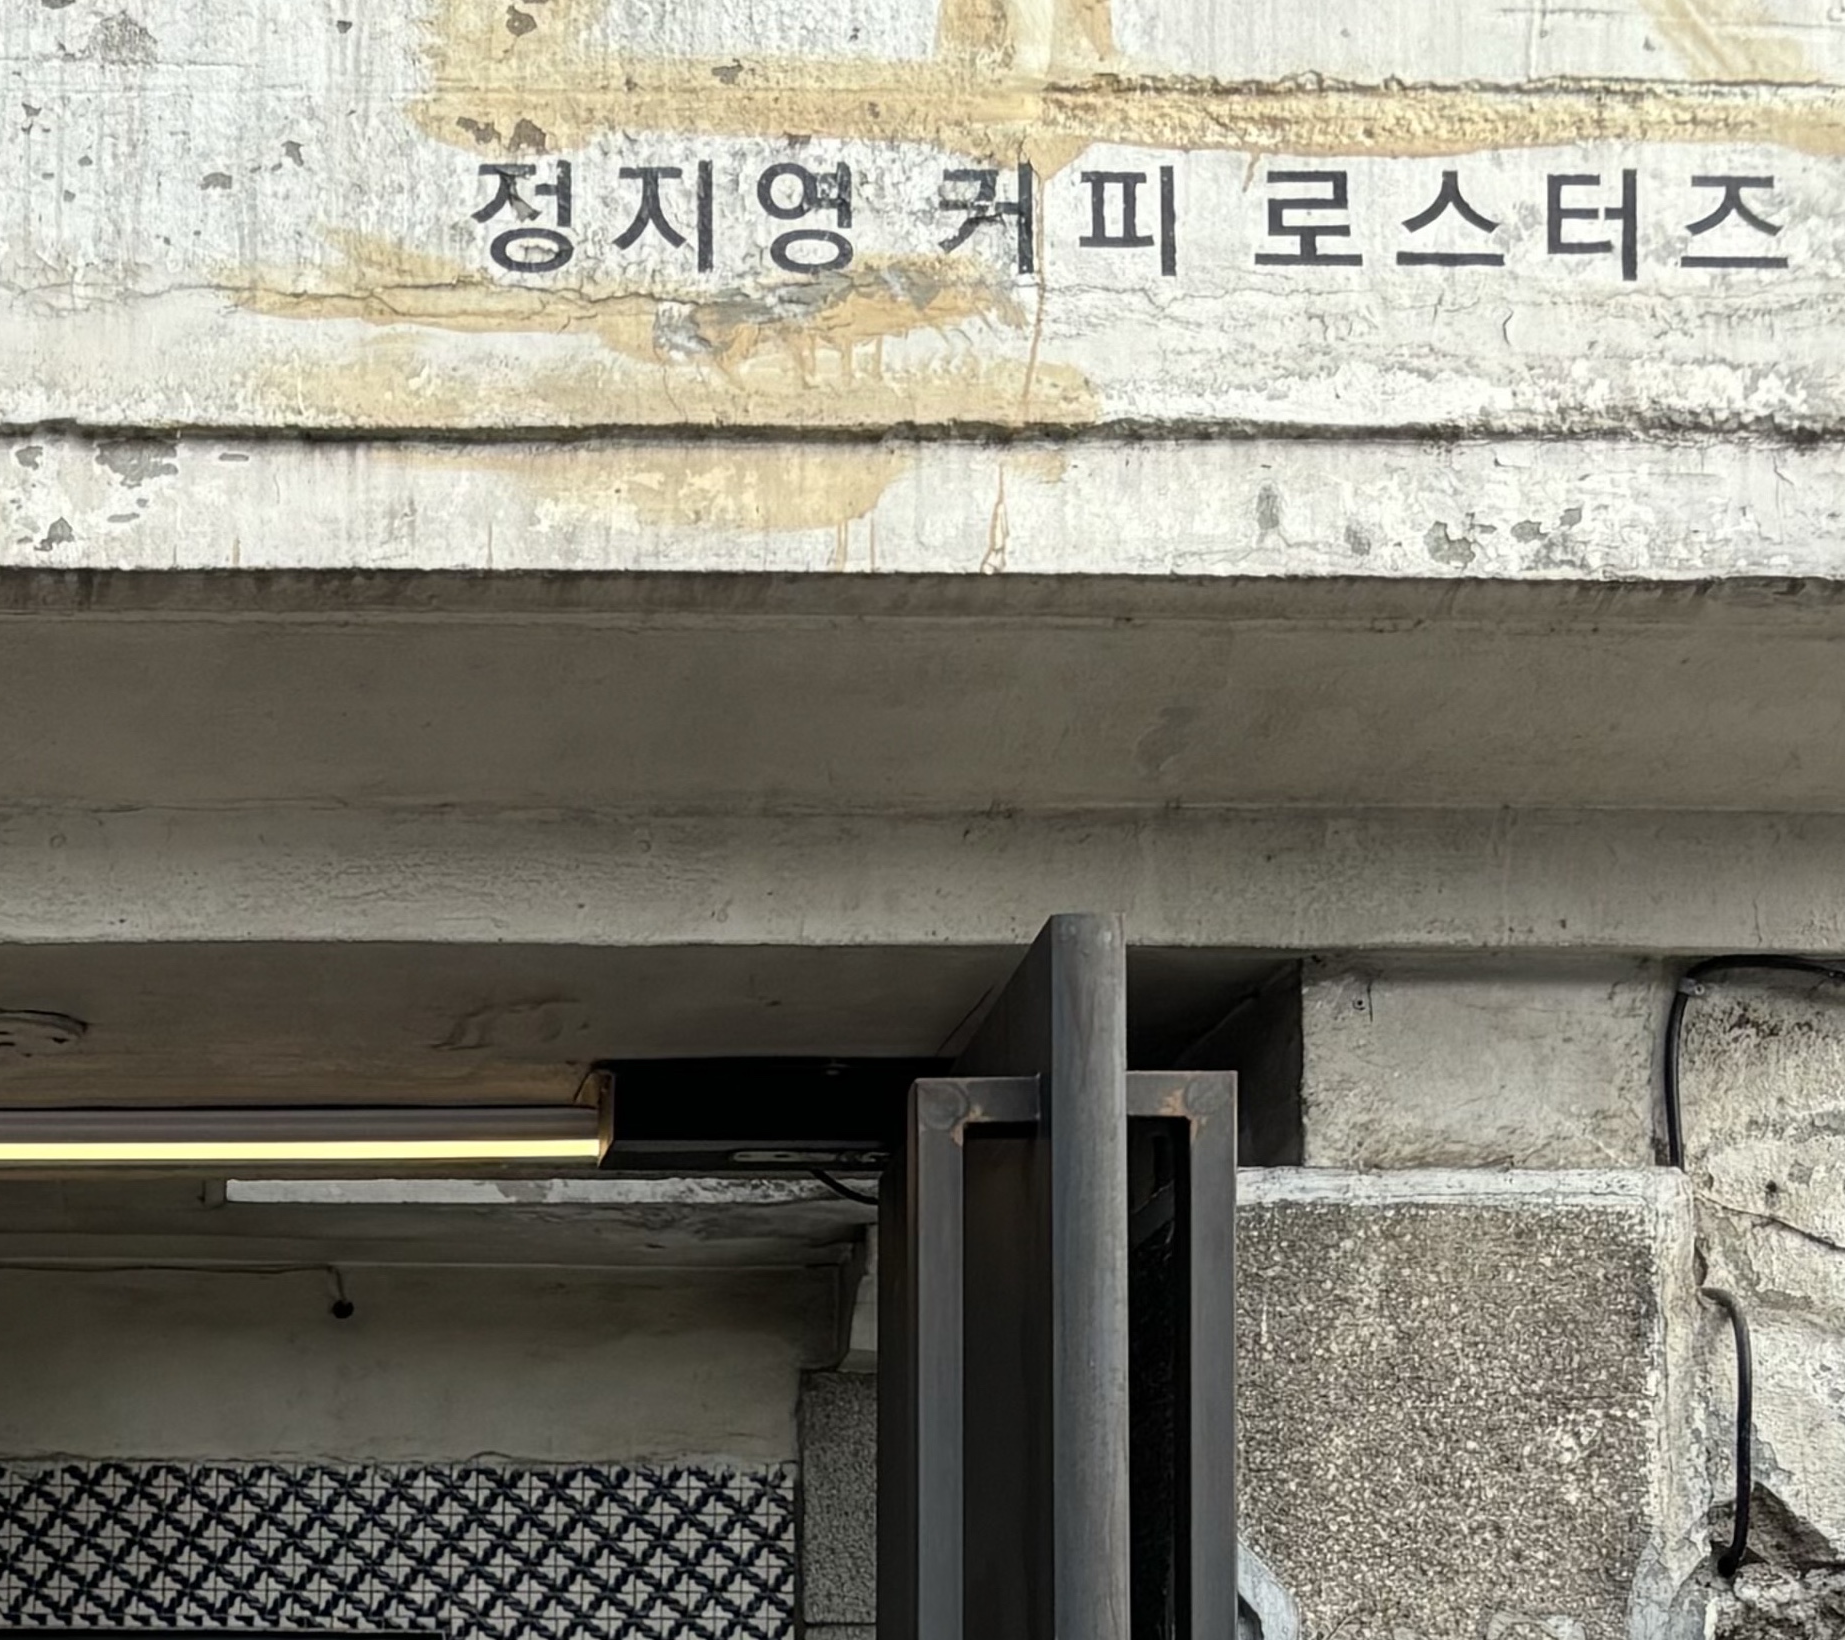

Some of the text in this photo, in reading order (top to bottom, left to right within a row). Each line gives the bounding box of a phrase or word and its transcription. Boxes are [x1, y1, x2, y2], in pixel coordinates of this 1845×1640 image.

[469, 159, 1791, 281] 정지영 커피 로스터즈
